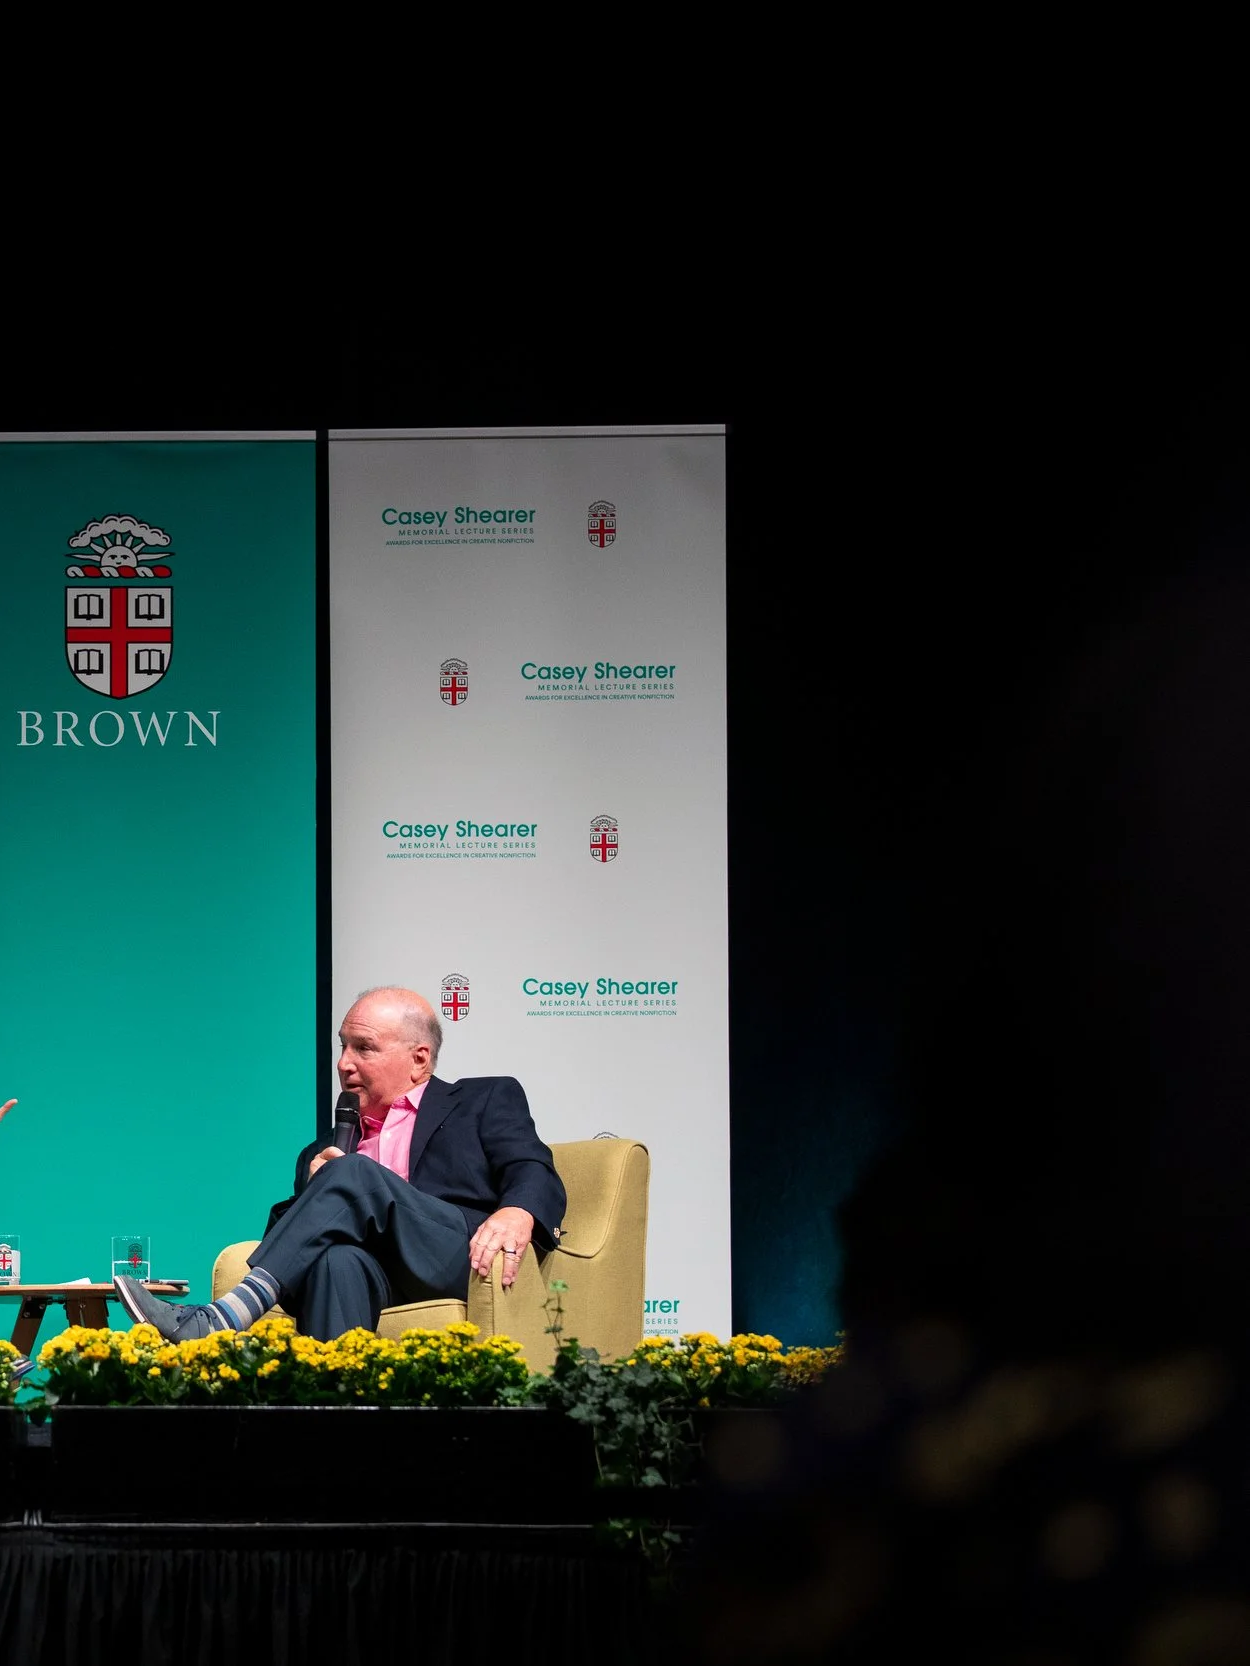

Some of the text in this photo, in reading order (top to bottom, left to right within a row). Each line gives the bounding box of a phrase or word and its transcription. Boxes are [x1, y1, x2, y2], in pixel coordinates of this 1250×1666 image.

[382, 507, 535, 527] Casey Shearer
[521, 662, 675, 683] Casey Shearer
[16, 710, 221, 747] BROWN
[382, 821, 538, 841] Casey Shearer
[523, 978, 678, 998] Casey Shearer
[644, 1300, 680, 1313] arer
